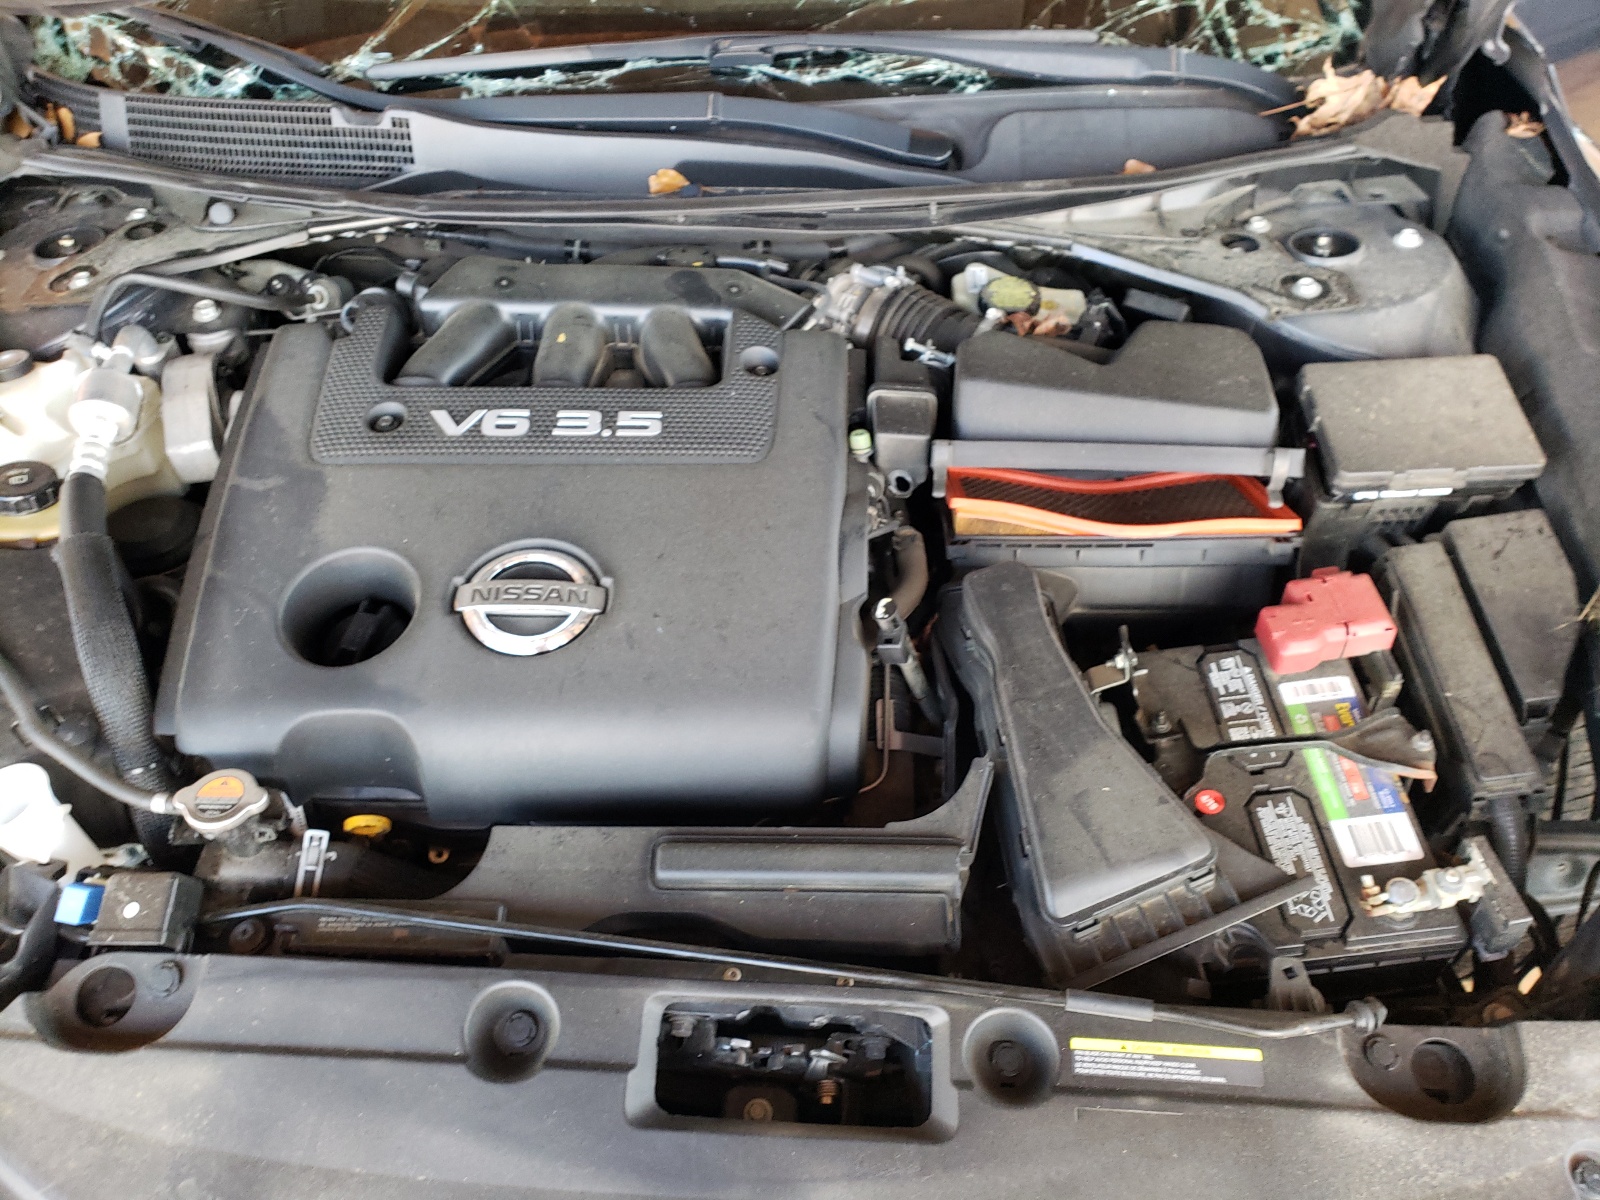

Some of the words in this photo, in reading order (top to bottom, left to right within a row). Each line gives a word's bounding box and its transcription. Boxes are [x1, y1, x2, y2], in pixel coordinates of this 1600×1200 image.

[430, 409, 531, 437] V6
[552, 410, 663, 437] 3.5
[471, 584, 588, 604] NISSAN
